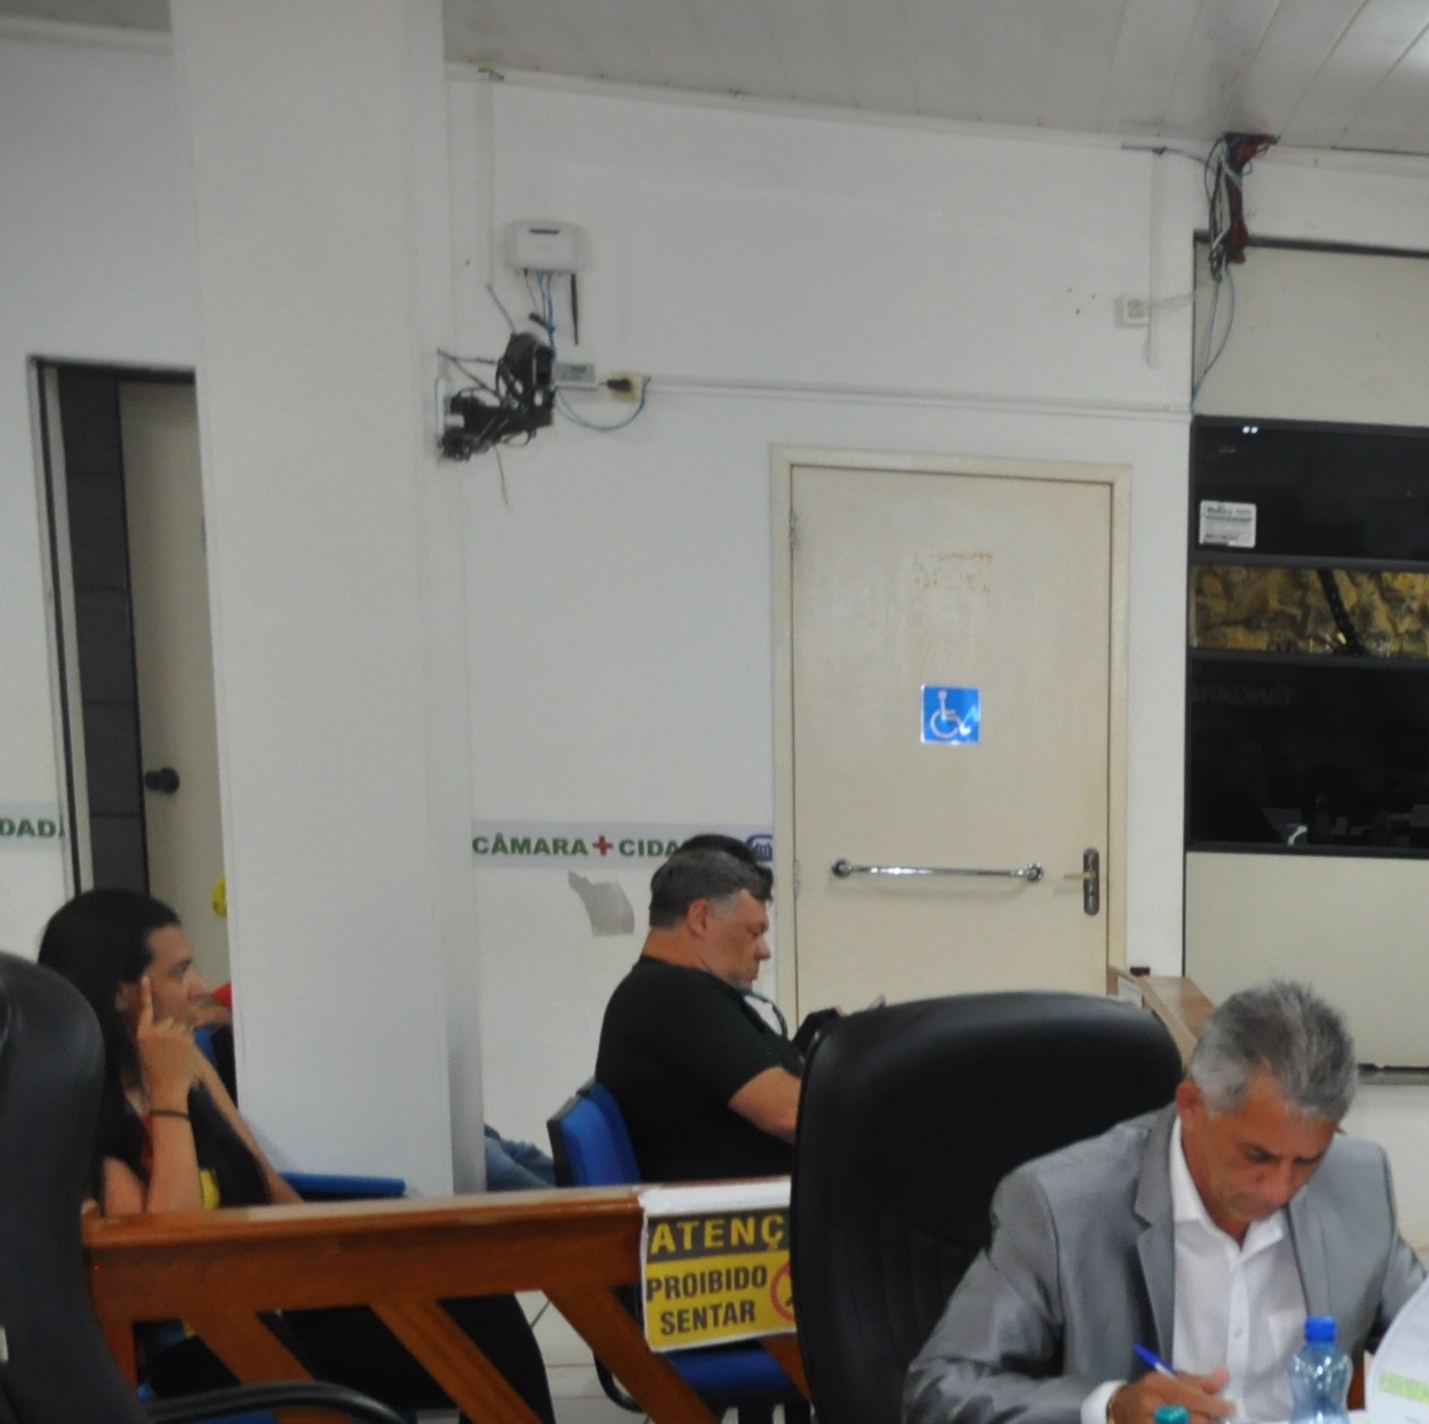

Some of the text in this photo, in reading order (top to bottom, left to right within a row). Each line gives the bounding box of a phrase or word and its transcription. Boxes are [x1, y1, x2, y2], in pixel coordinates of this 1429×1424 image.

[472, 832, 589, 856] CÂMARA
[650, 1213, 786, 1255] ATENÇ
[646, 1264, 768, 1303] PROIBIDO
[660, 1300, 756, 1337] SENTAR
